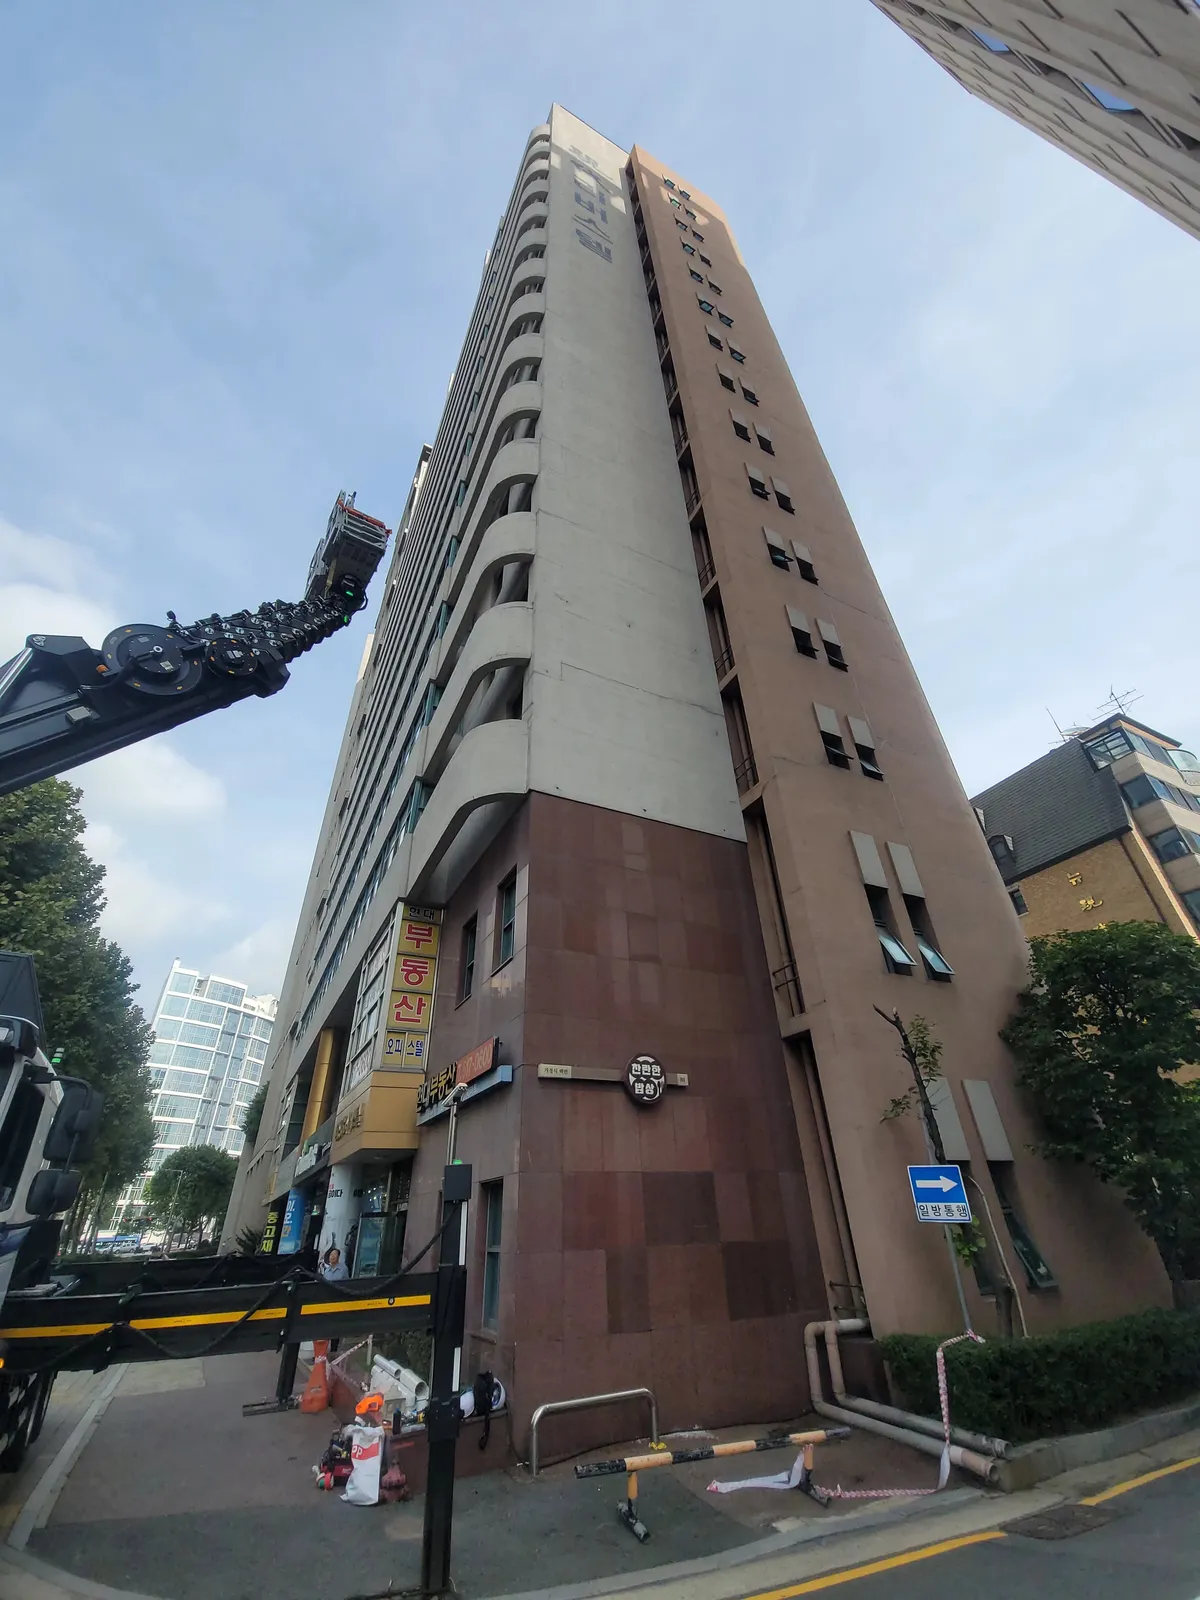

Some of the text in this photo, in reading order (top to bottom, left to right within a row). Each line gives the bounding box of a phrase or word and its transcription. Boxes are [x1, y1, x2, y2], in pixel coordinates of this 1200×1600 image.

[409, 906, 435, 920] 현대
[394, 923, 433, 1024] 부동산
[385, 1038, 424, 1057] 오피스텔
[631, 1063, 661, 1076] 찬란한
[634, 1082, 655, 1095] 밥상
[919, 1204, 968, 1218] 일방통행
